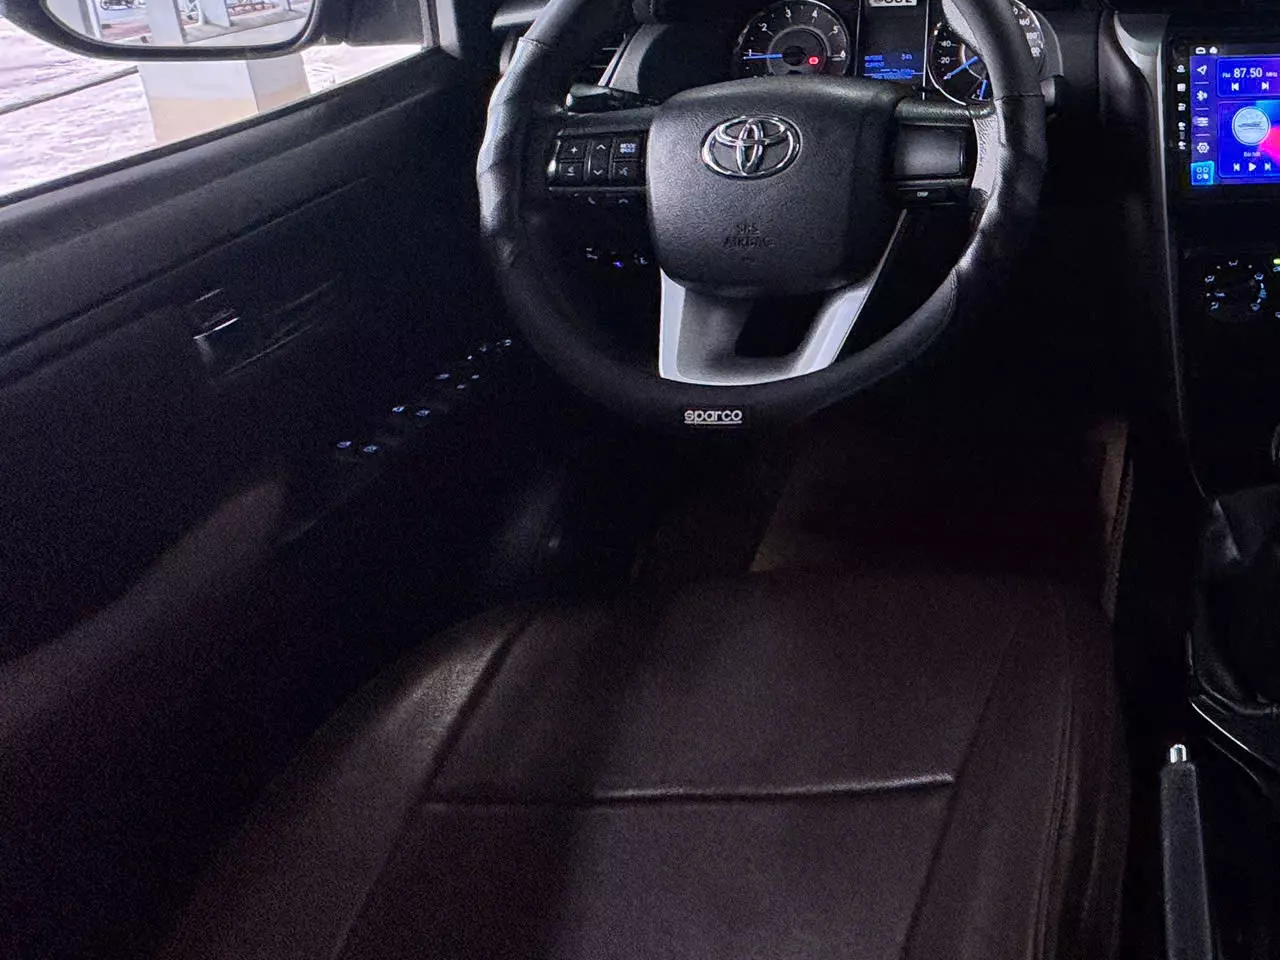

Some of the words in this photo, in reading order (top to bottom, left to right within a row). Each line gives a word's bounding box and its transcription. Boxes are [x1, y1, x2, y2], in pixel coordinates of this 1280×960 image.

[941, 40, 952, 48] 40
[940, 56, 951, 64] 20
[1233, 67, 1263, 78] 87.50
[684, 410, 743, 425] sparco
